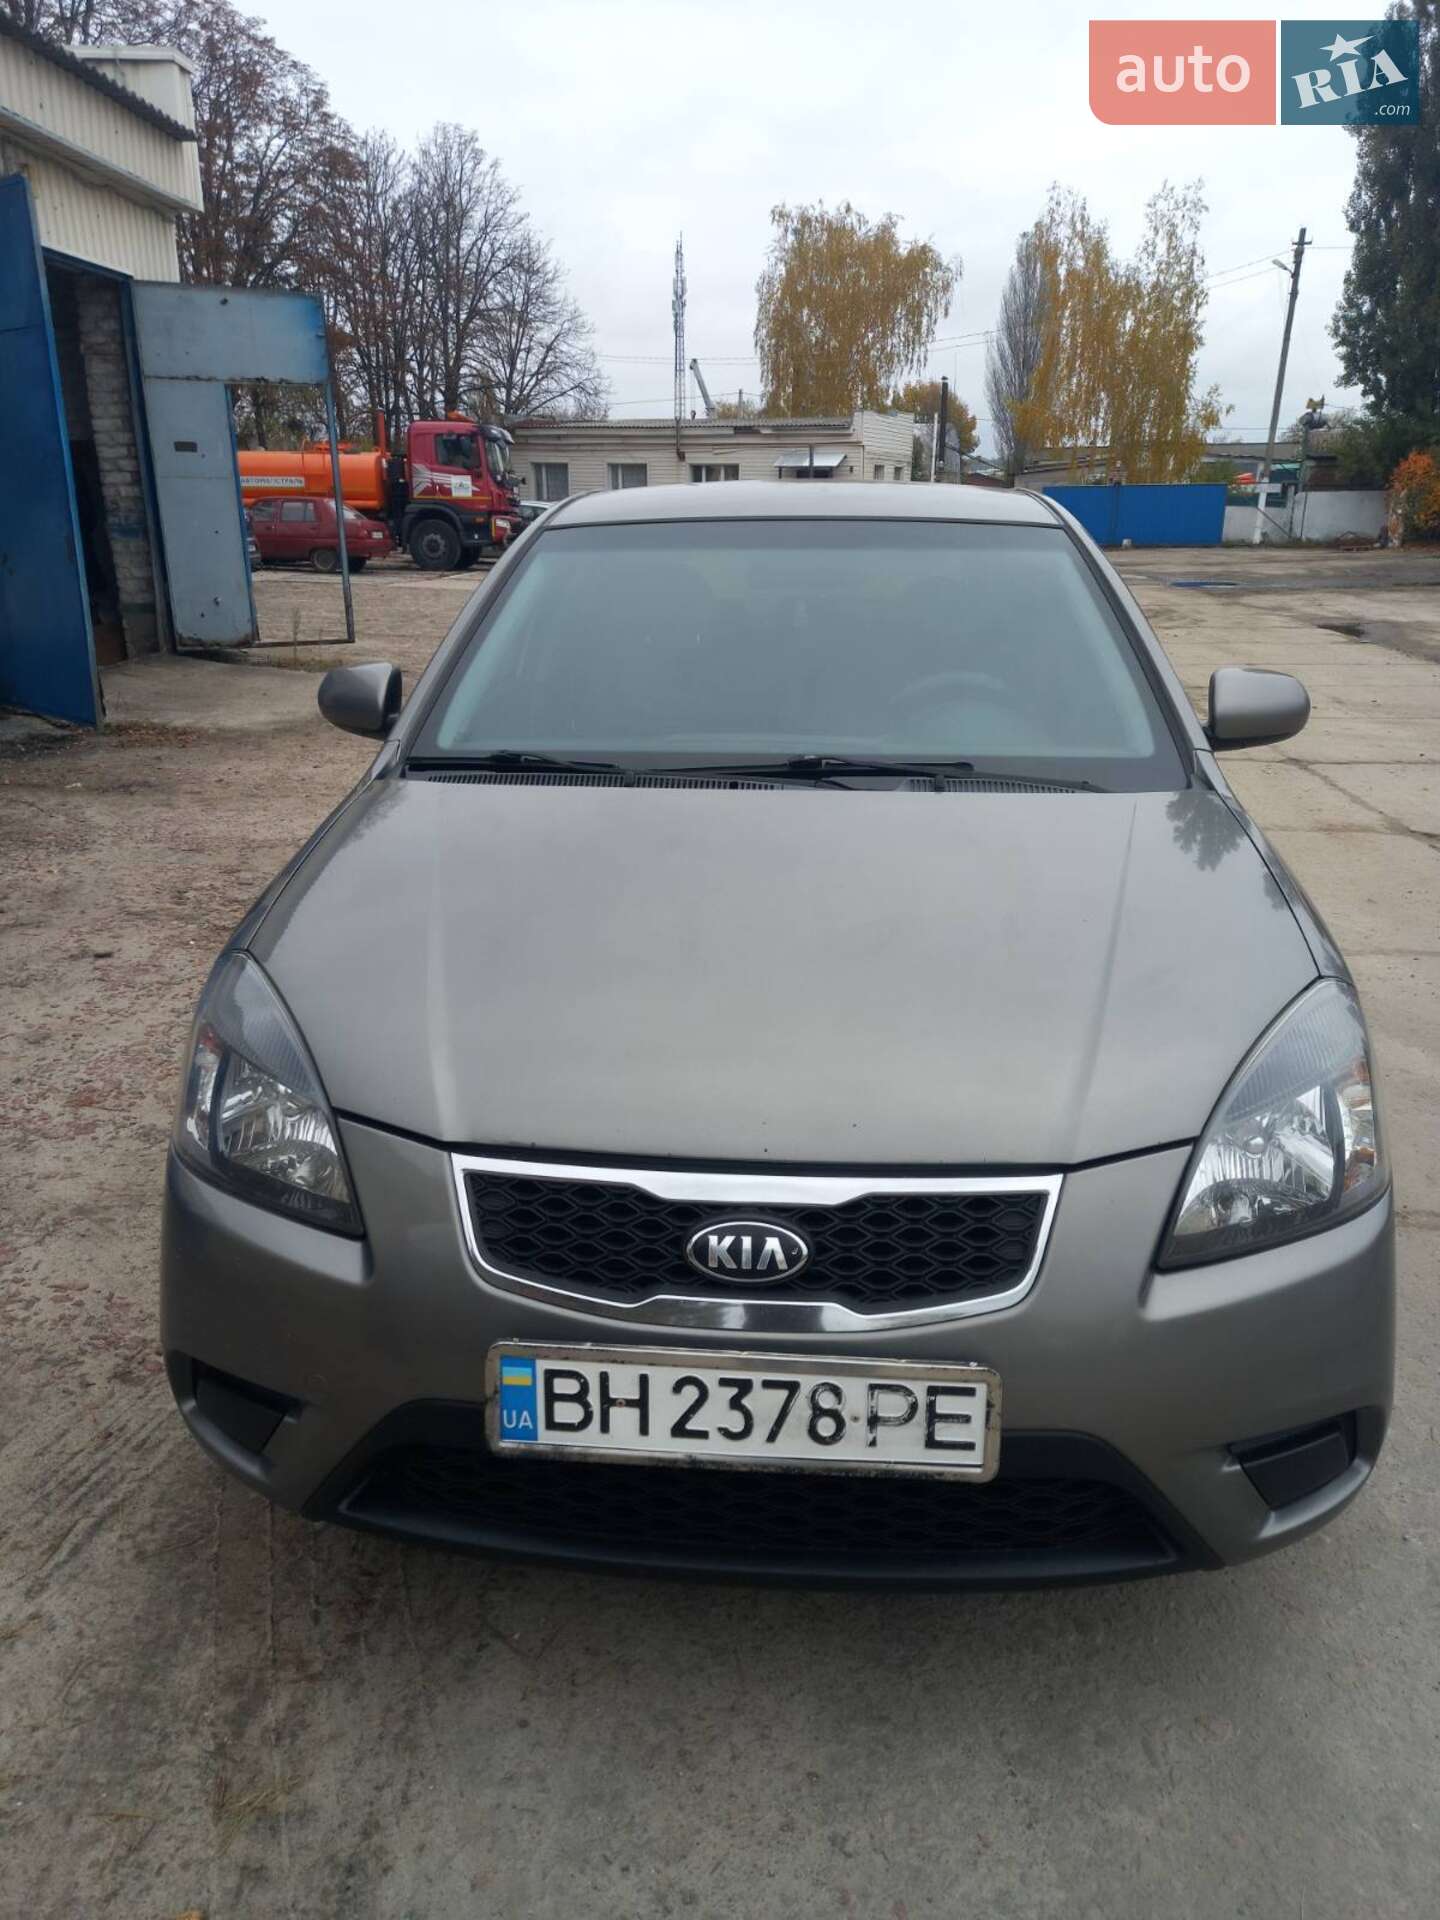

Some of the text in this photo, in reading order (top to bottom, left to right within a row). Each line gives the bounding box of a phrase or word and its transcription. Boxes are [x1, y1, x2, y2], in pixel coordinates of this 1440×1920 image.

[708, 1235, 788, 1270] KIA
[503, 1409, 533, 1430] UA
[544, 1368, 976, 1450] BH 2378 PE
